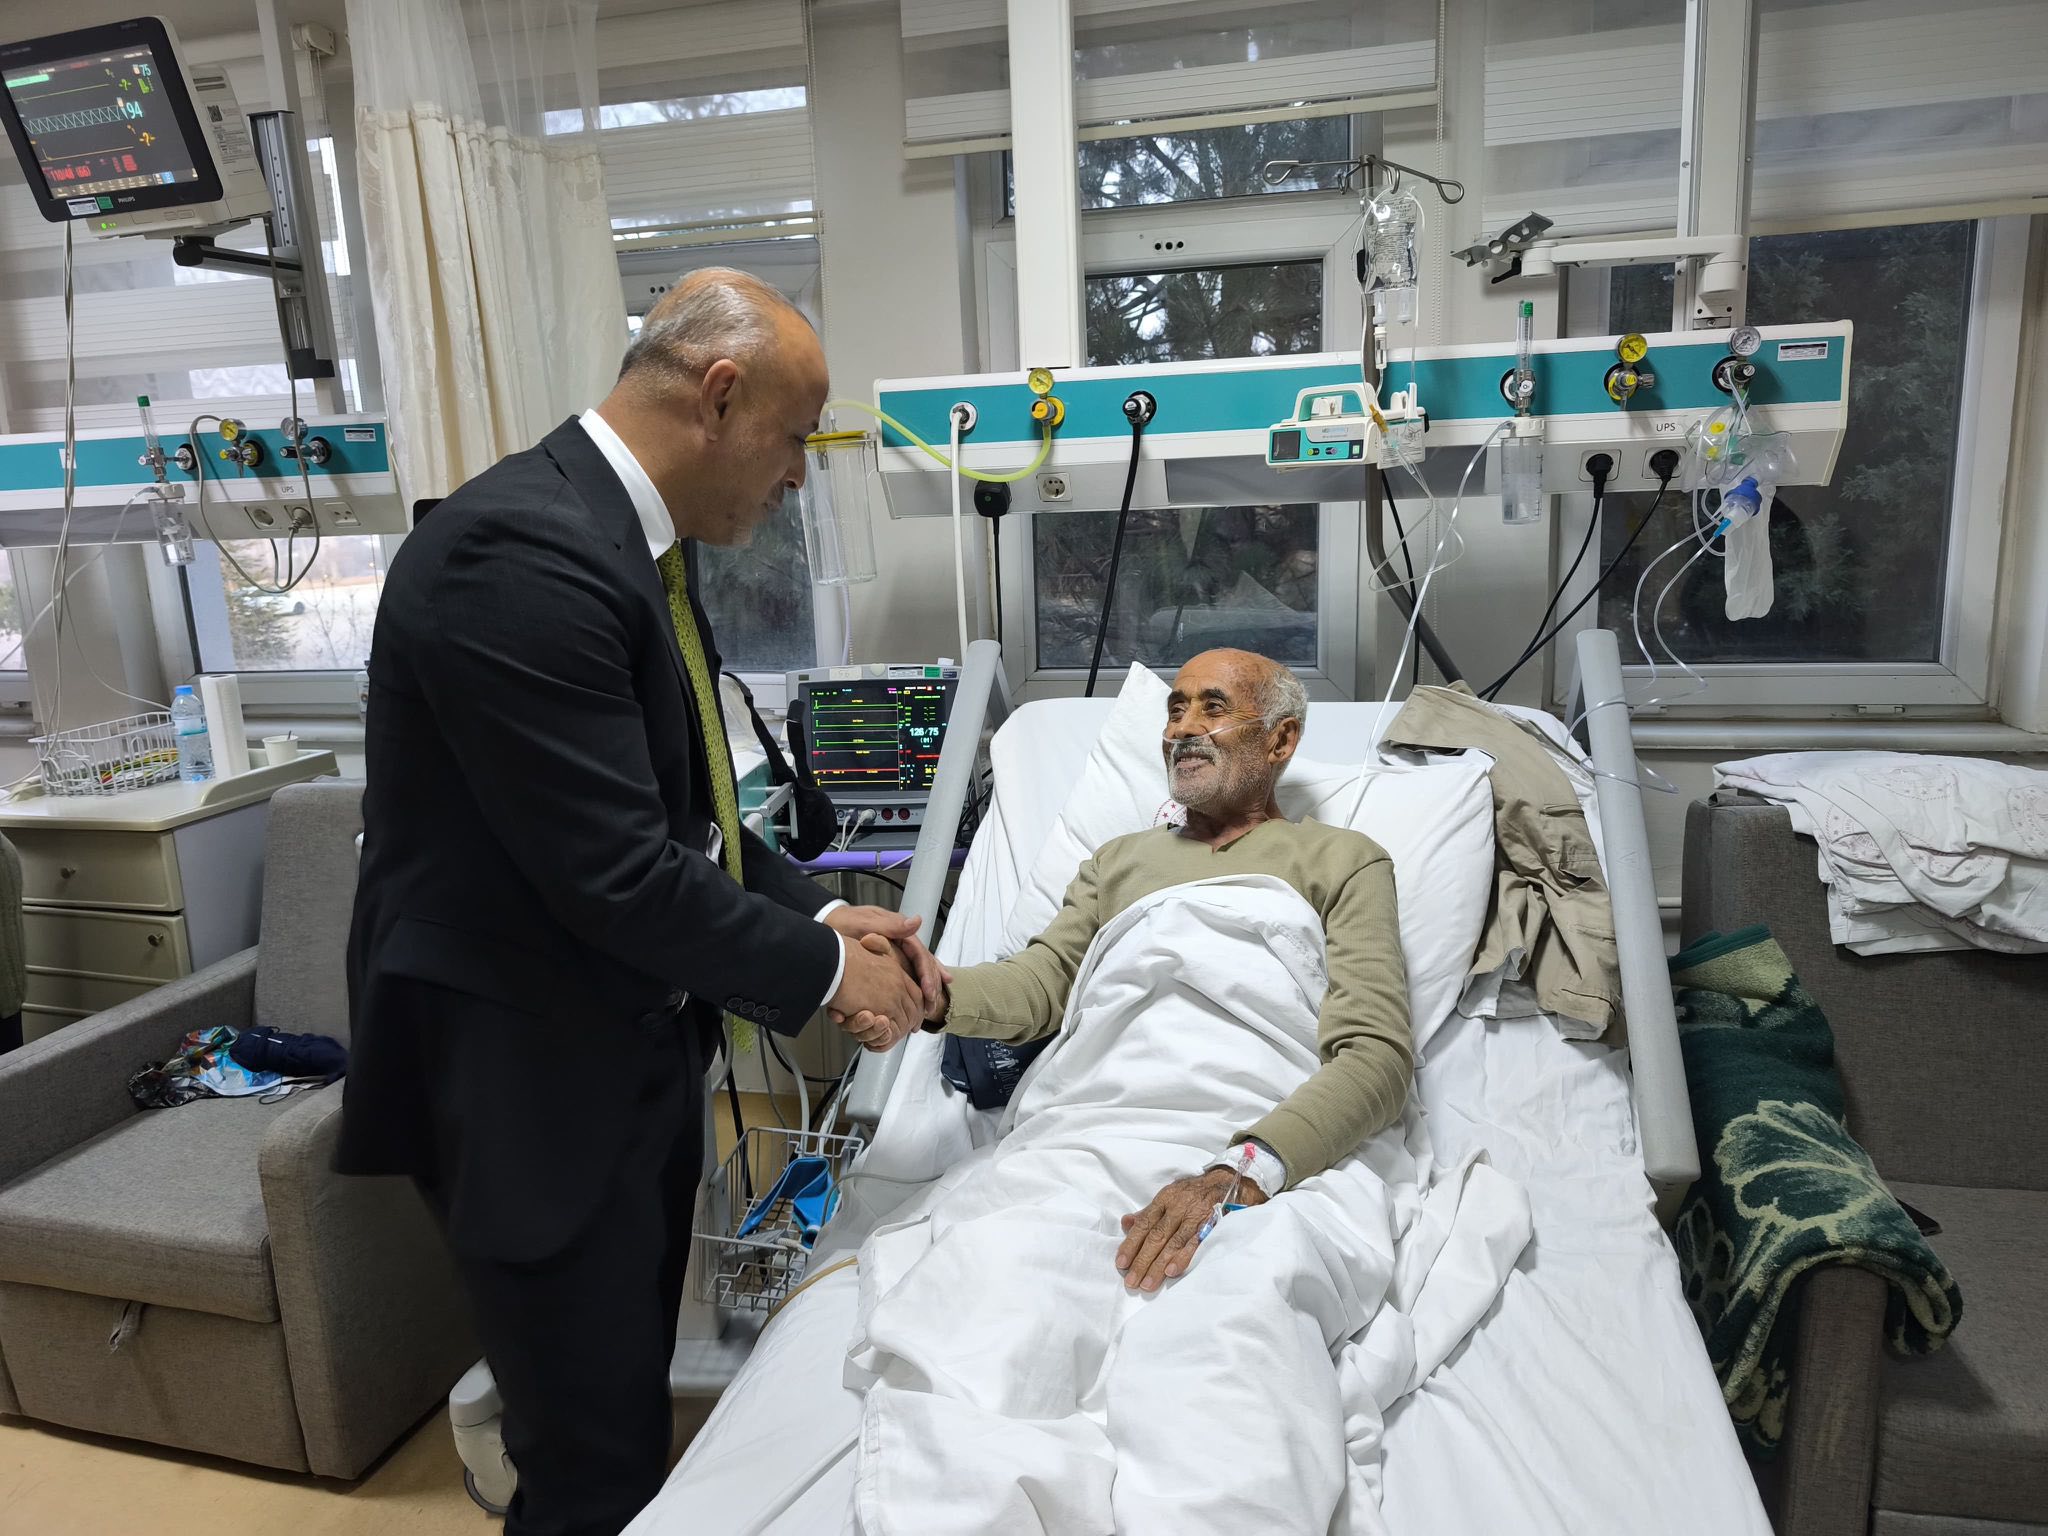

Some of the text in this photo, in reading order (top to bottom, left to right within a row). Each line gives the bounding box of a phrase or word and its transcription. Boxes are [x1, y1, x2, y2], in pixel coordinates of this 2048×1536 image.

[138, 63, 152, 77] 75
[125, 100, 144, 119] 94
[1656, 422, 1677, 432] UPS
[281, 485, 296, 494] UPS
